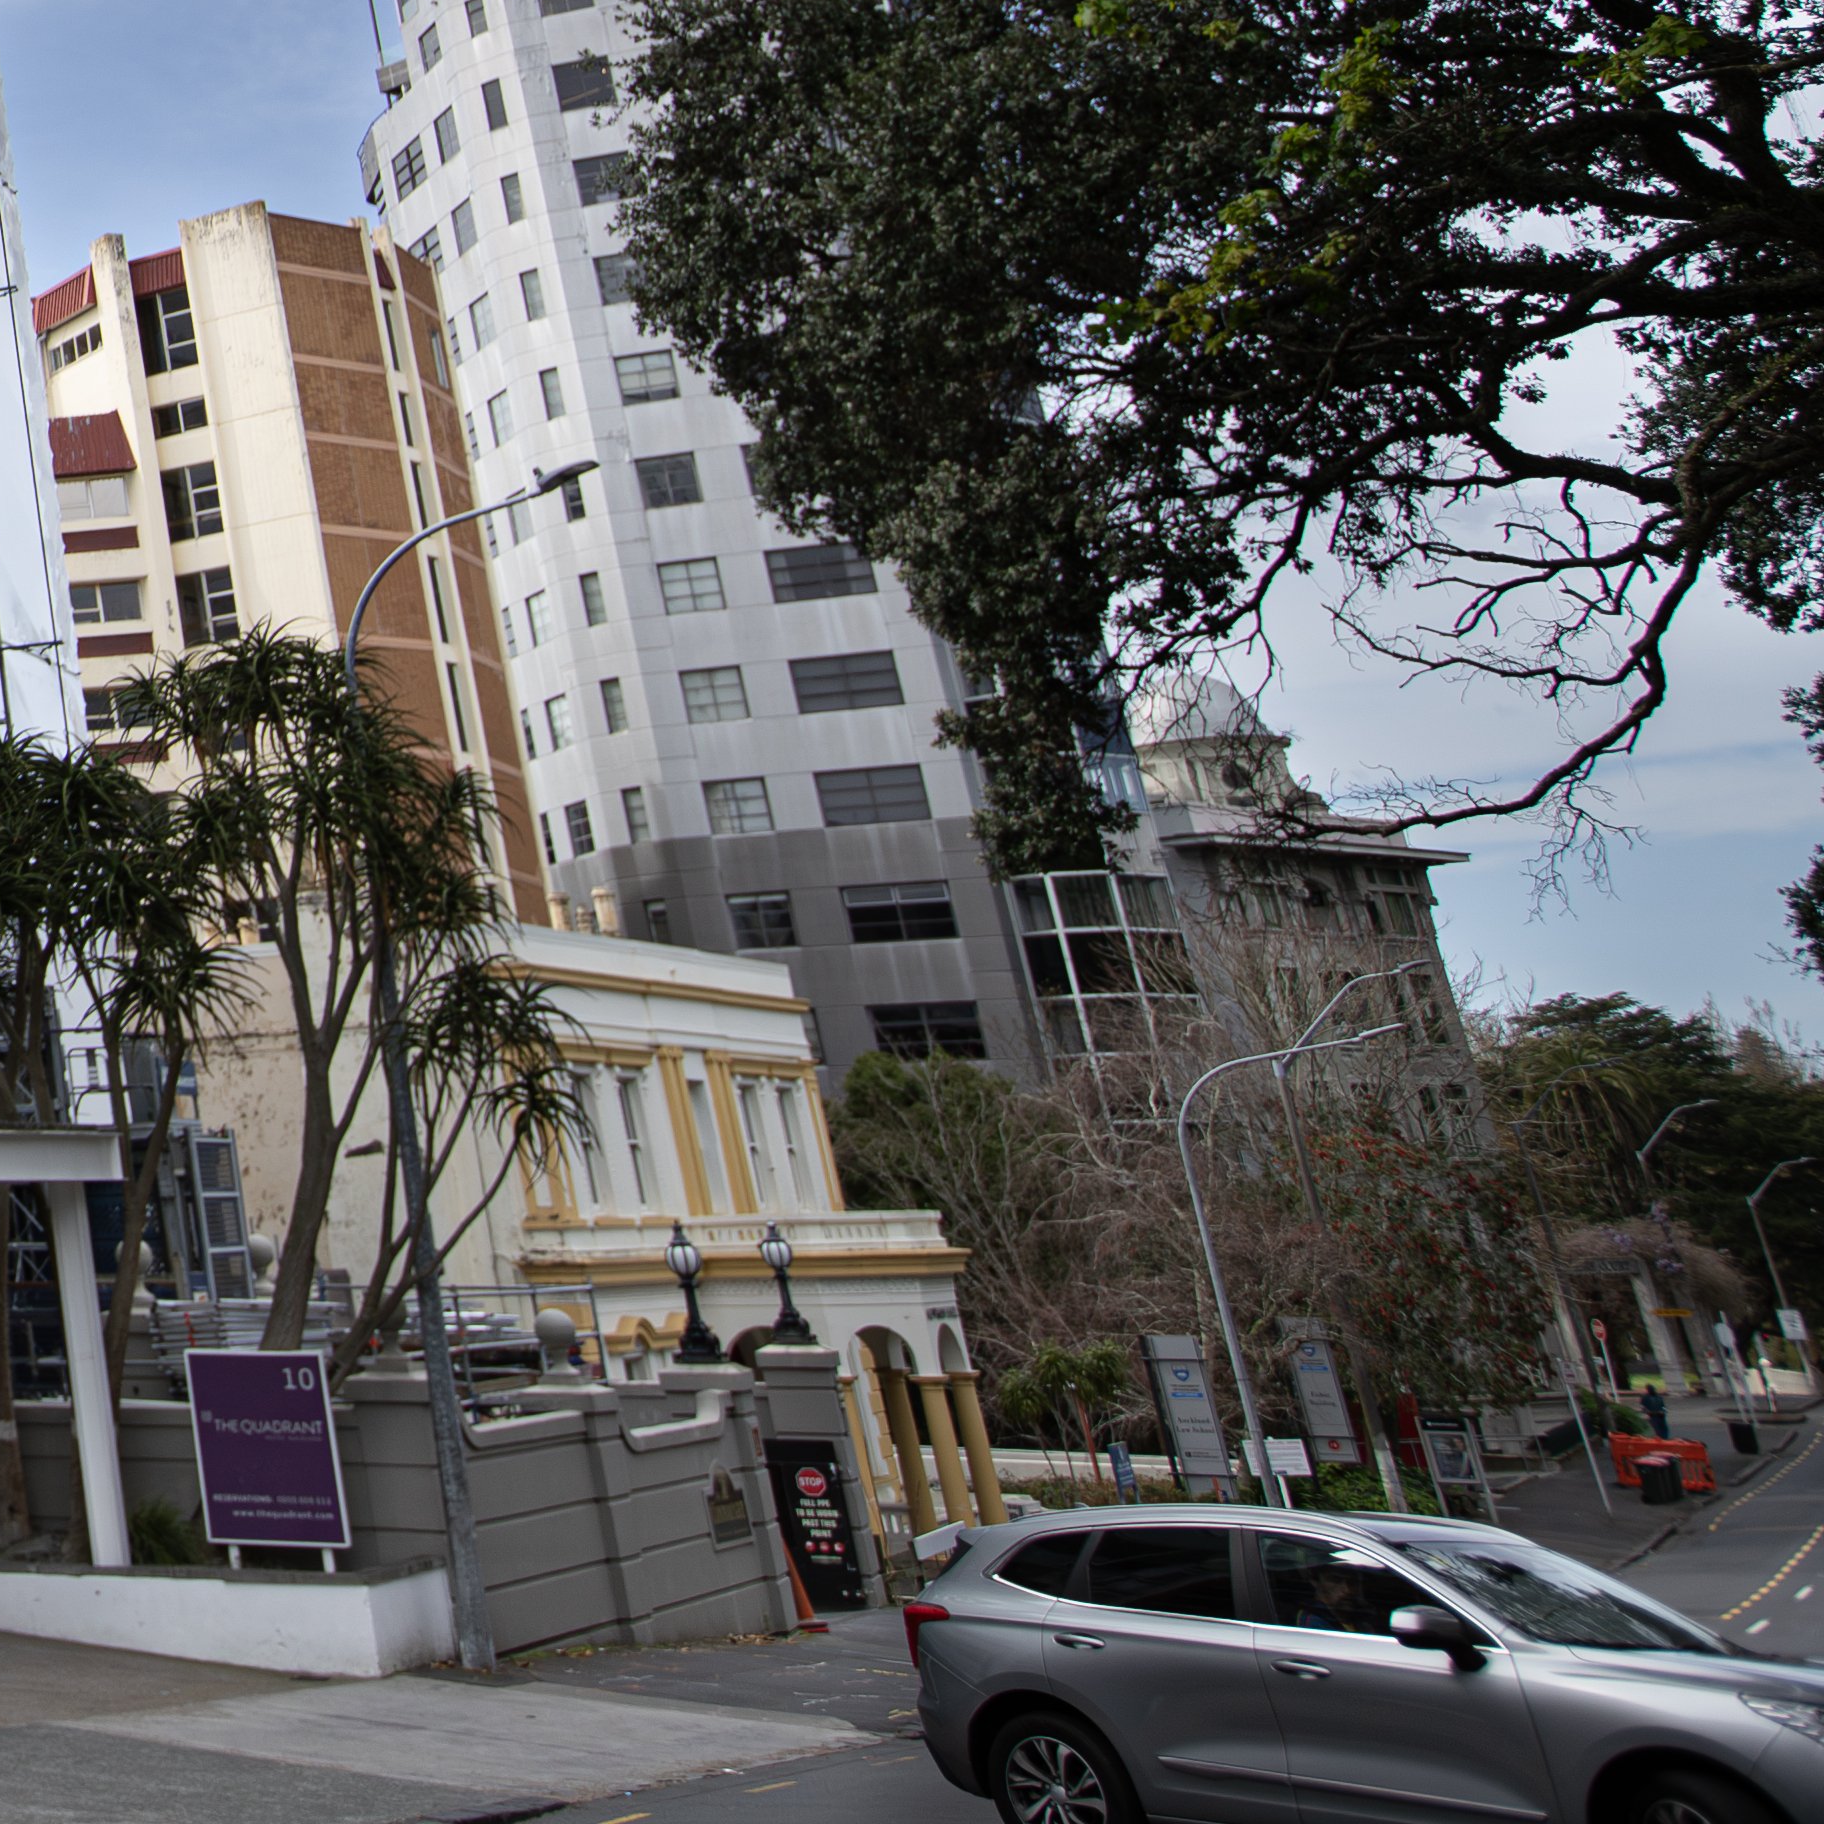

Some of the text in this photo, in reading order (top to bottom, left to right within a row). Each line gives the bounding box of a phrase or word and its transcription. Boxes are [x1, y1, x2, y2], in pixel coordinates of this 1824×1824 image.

[282, 1367, 315, 1392] 10
[239, 1419, 323, 1436] QUADRANT
[798, 1477, 822, 1487] STOP
